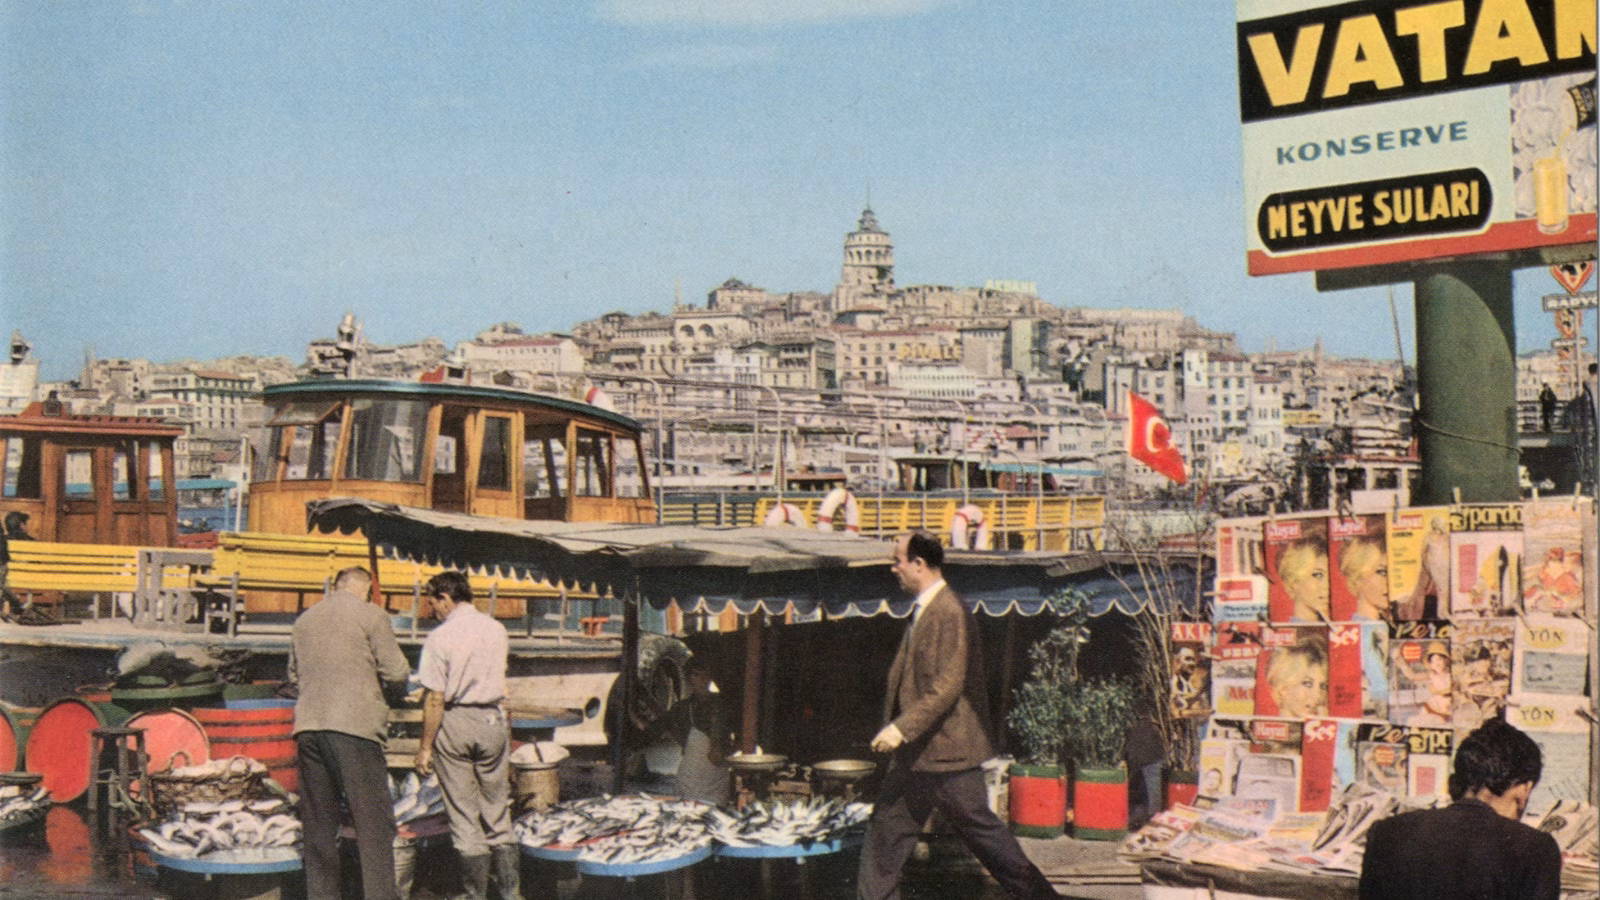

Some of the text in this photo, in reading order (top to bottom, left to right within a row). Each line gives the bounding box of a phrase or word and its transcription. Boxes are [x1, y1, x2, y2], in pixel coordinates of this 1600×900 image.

[1247, 0, 1597, 107] VATAN
[1276, 121, 1469, 165] KONSERVE
[1267, 180, 1479, 240] MEYVE SULARI
